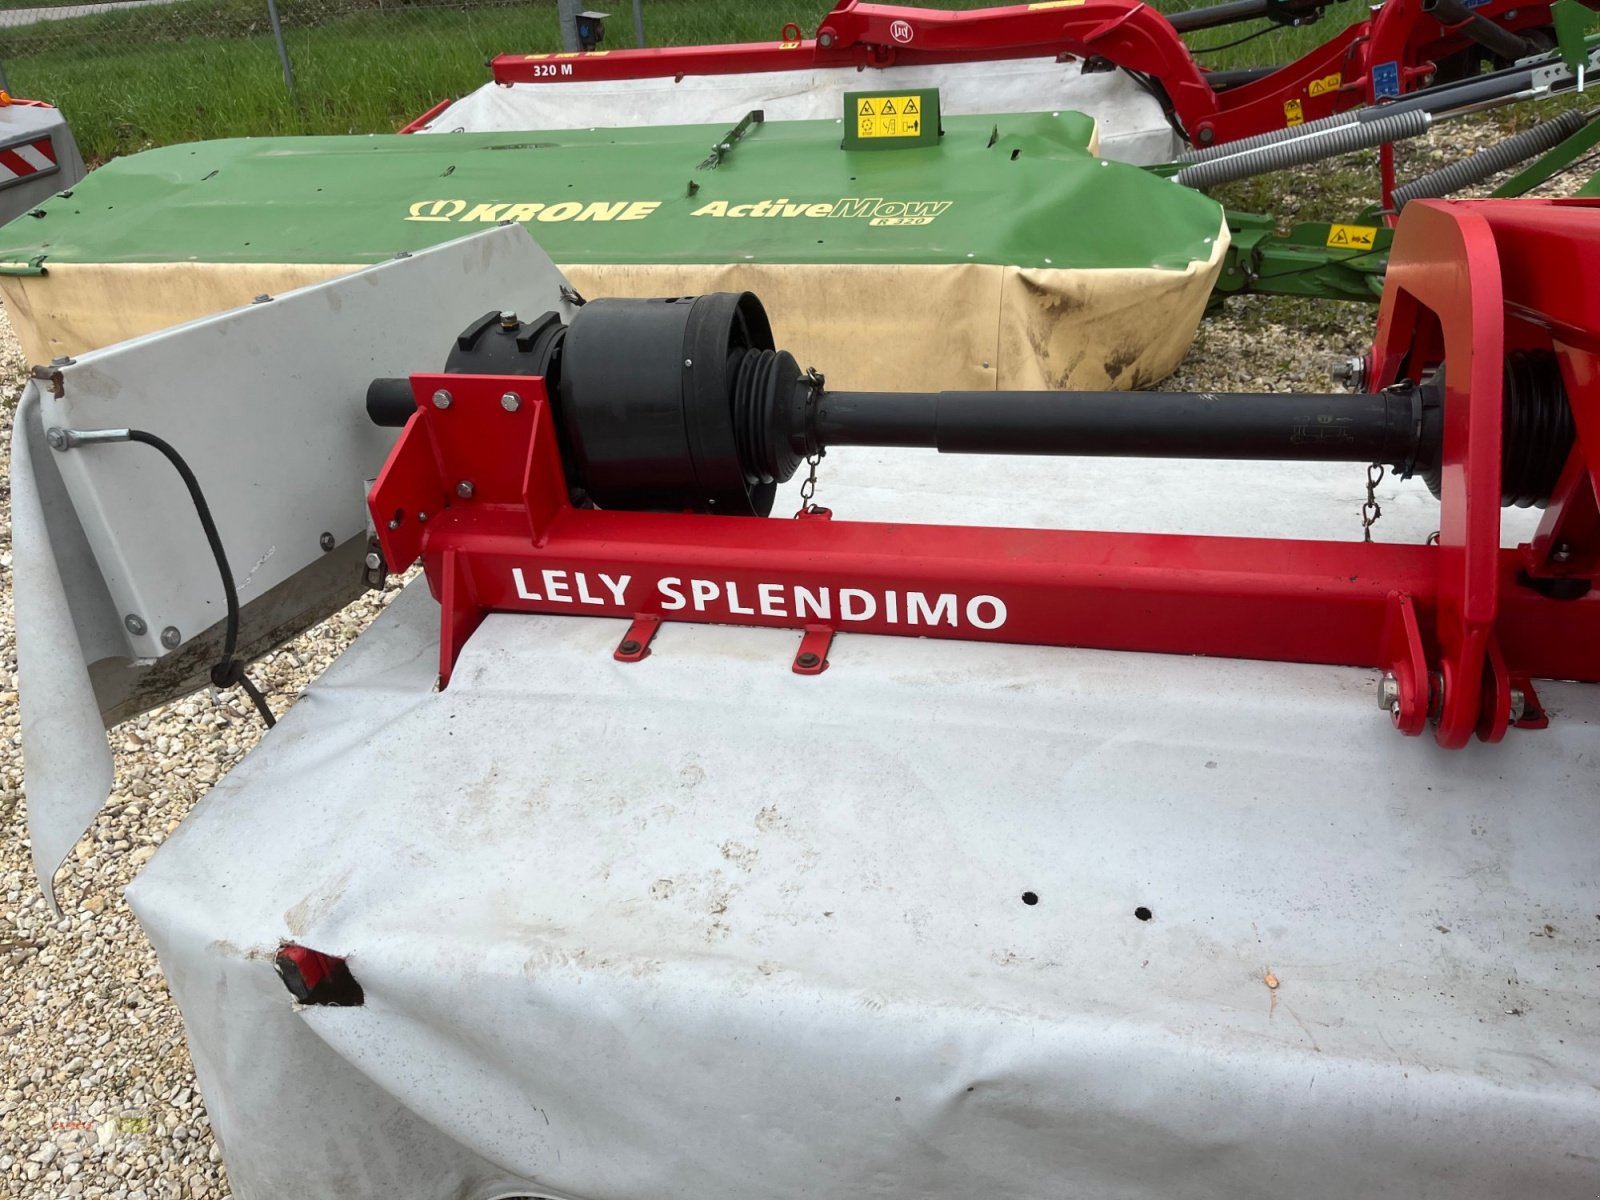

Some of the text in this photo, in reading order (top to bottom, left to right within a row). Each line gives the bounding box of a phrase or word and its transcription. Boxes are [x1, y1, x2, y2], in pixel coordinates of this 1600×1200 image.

[533, 63, 573, 77] 320 M
[458, 201, 663, 222] KRONE
[690, 198, 953, 218] ActiveMow
[893, 217, 926, 225] 320
[512, 567, 1008, 630] LELY SPLENDIMO
